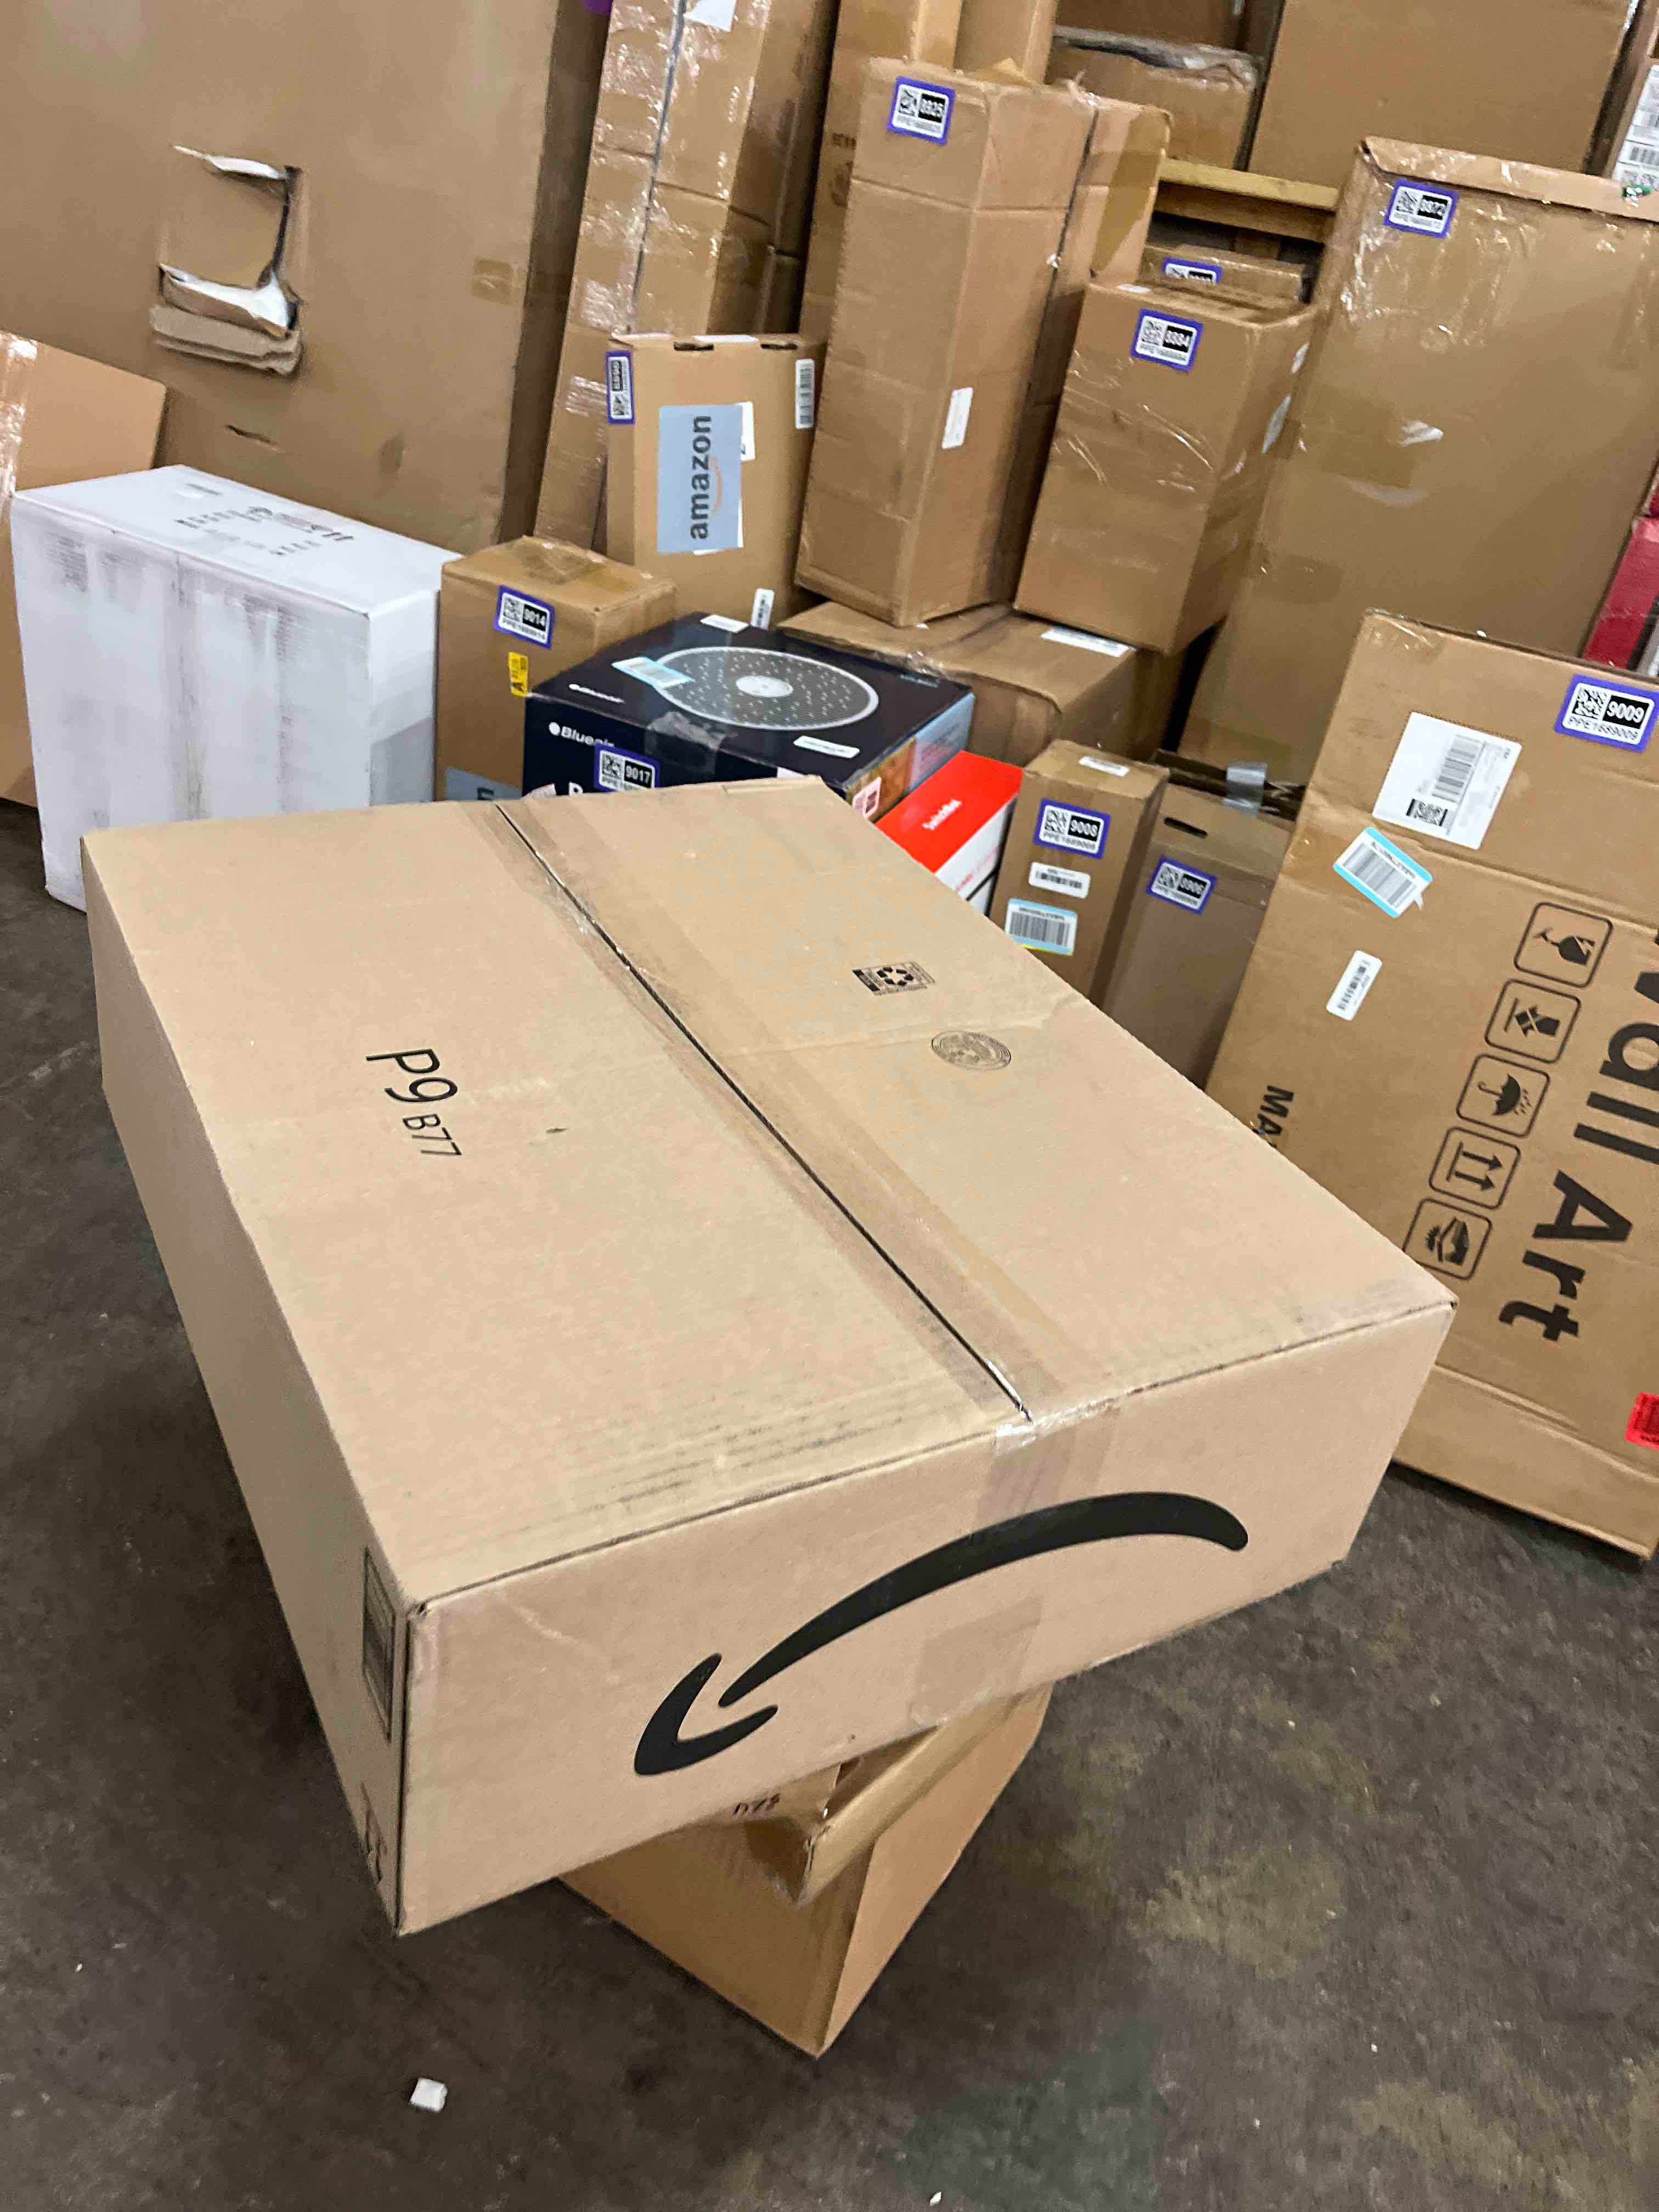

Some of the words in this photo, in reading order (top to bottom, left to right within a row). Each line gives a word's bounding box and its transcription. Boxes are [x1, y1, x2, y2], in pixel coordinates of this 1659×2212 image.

[690, 416, 712, 540] amazon
[1606, 701, 1645, 723] 9009
[625, 765, 651, 783] 9017
[1070, 819, 1098, 837] 9008
[1573, 927, 1659, 1165] all
[366, 1048, 458, 1102] P9
[402, 1113, 462, 1156] B77
[1252, 1085, 1294, 1148] MA
[1499, 1169, 1633, 1342] Art
